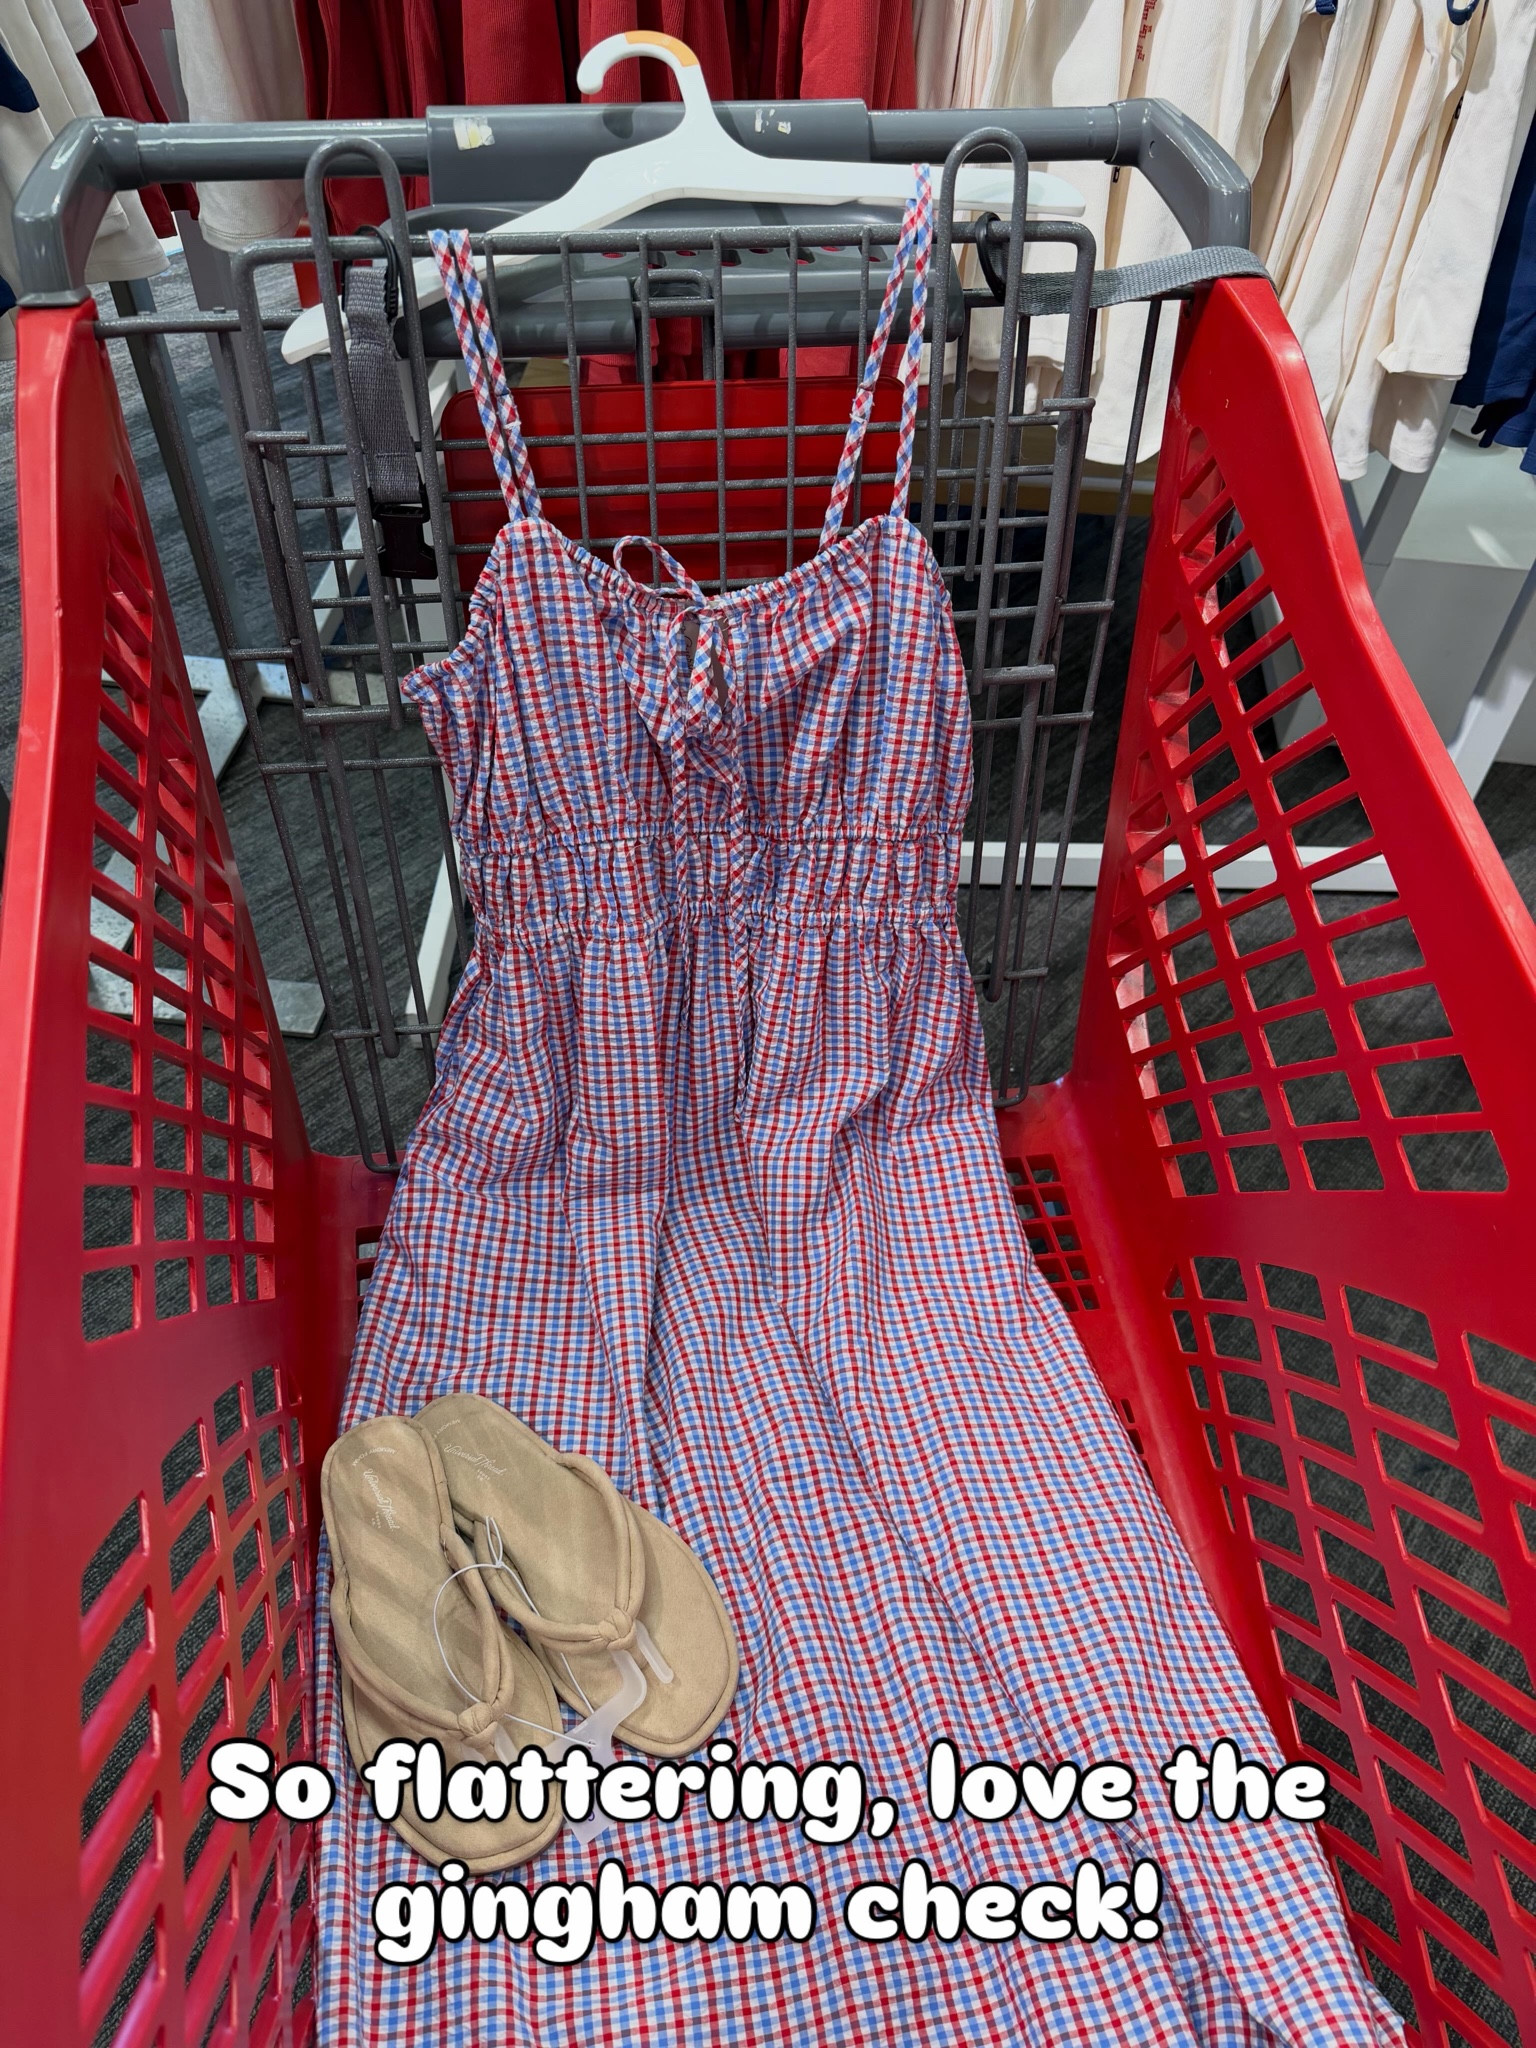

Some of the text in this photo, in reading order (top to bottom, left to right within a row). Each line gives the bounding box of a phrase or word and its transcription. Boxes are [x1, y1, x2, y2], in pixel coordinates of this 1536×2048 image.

[369, 1446, 396, 1455] MEMORY
[443, 1444, 482, 1463] Universal
[475, 1453, 507, 1475] Thread
[363, 1467, 389, 1504] Universal
[377, 1497, 400, 1532] Thread
